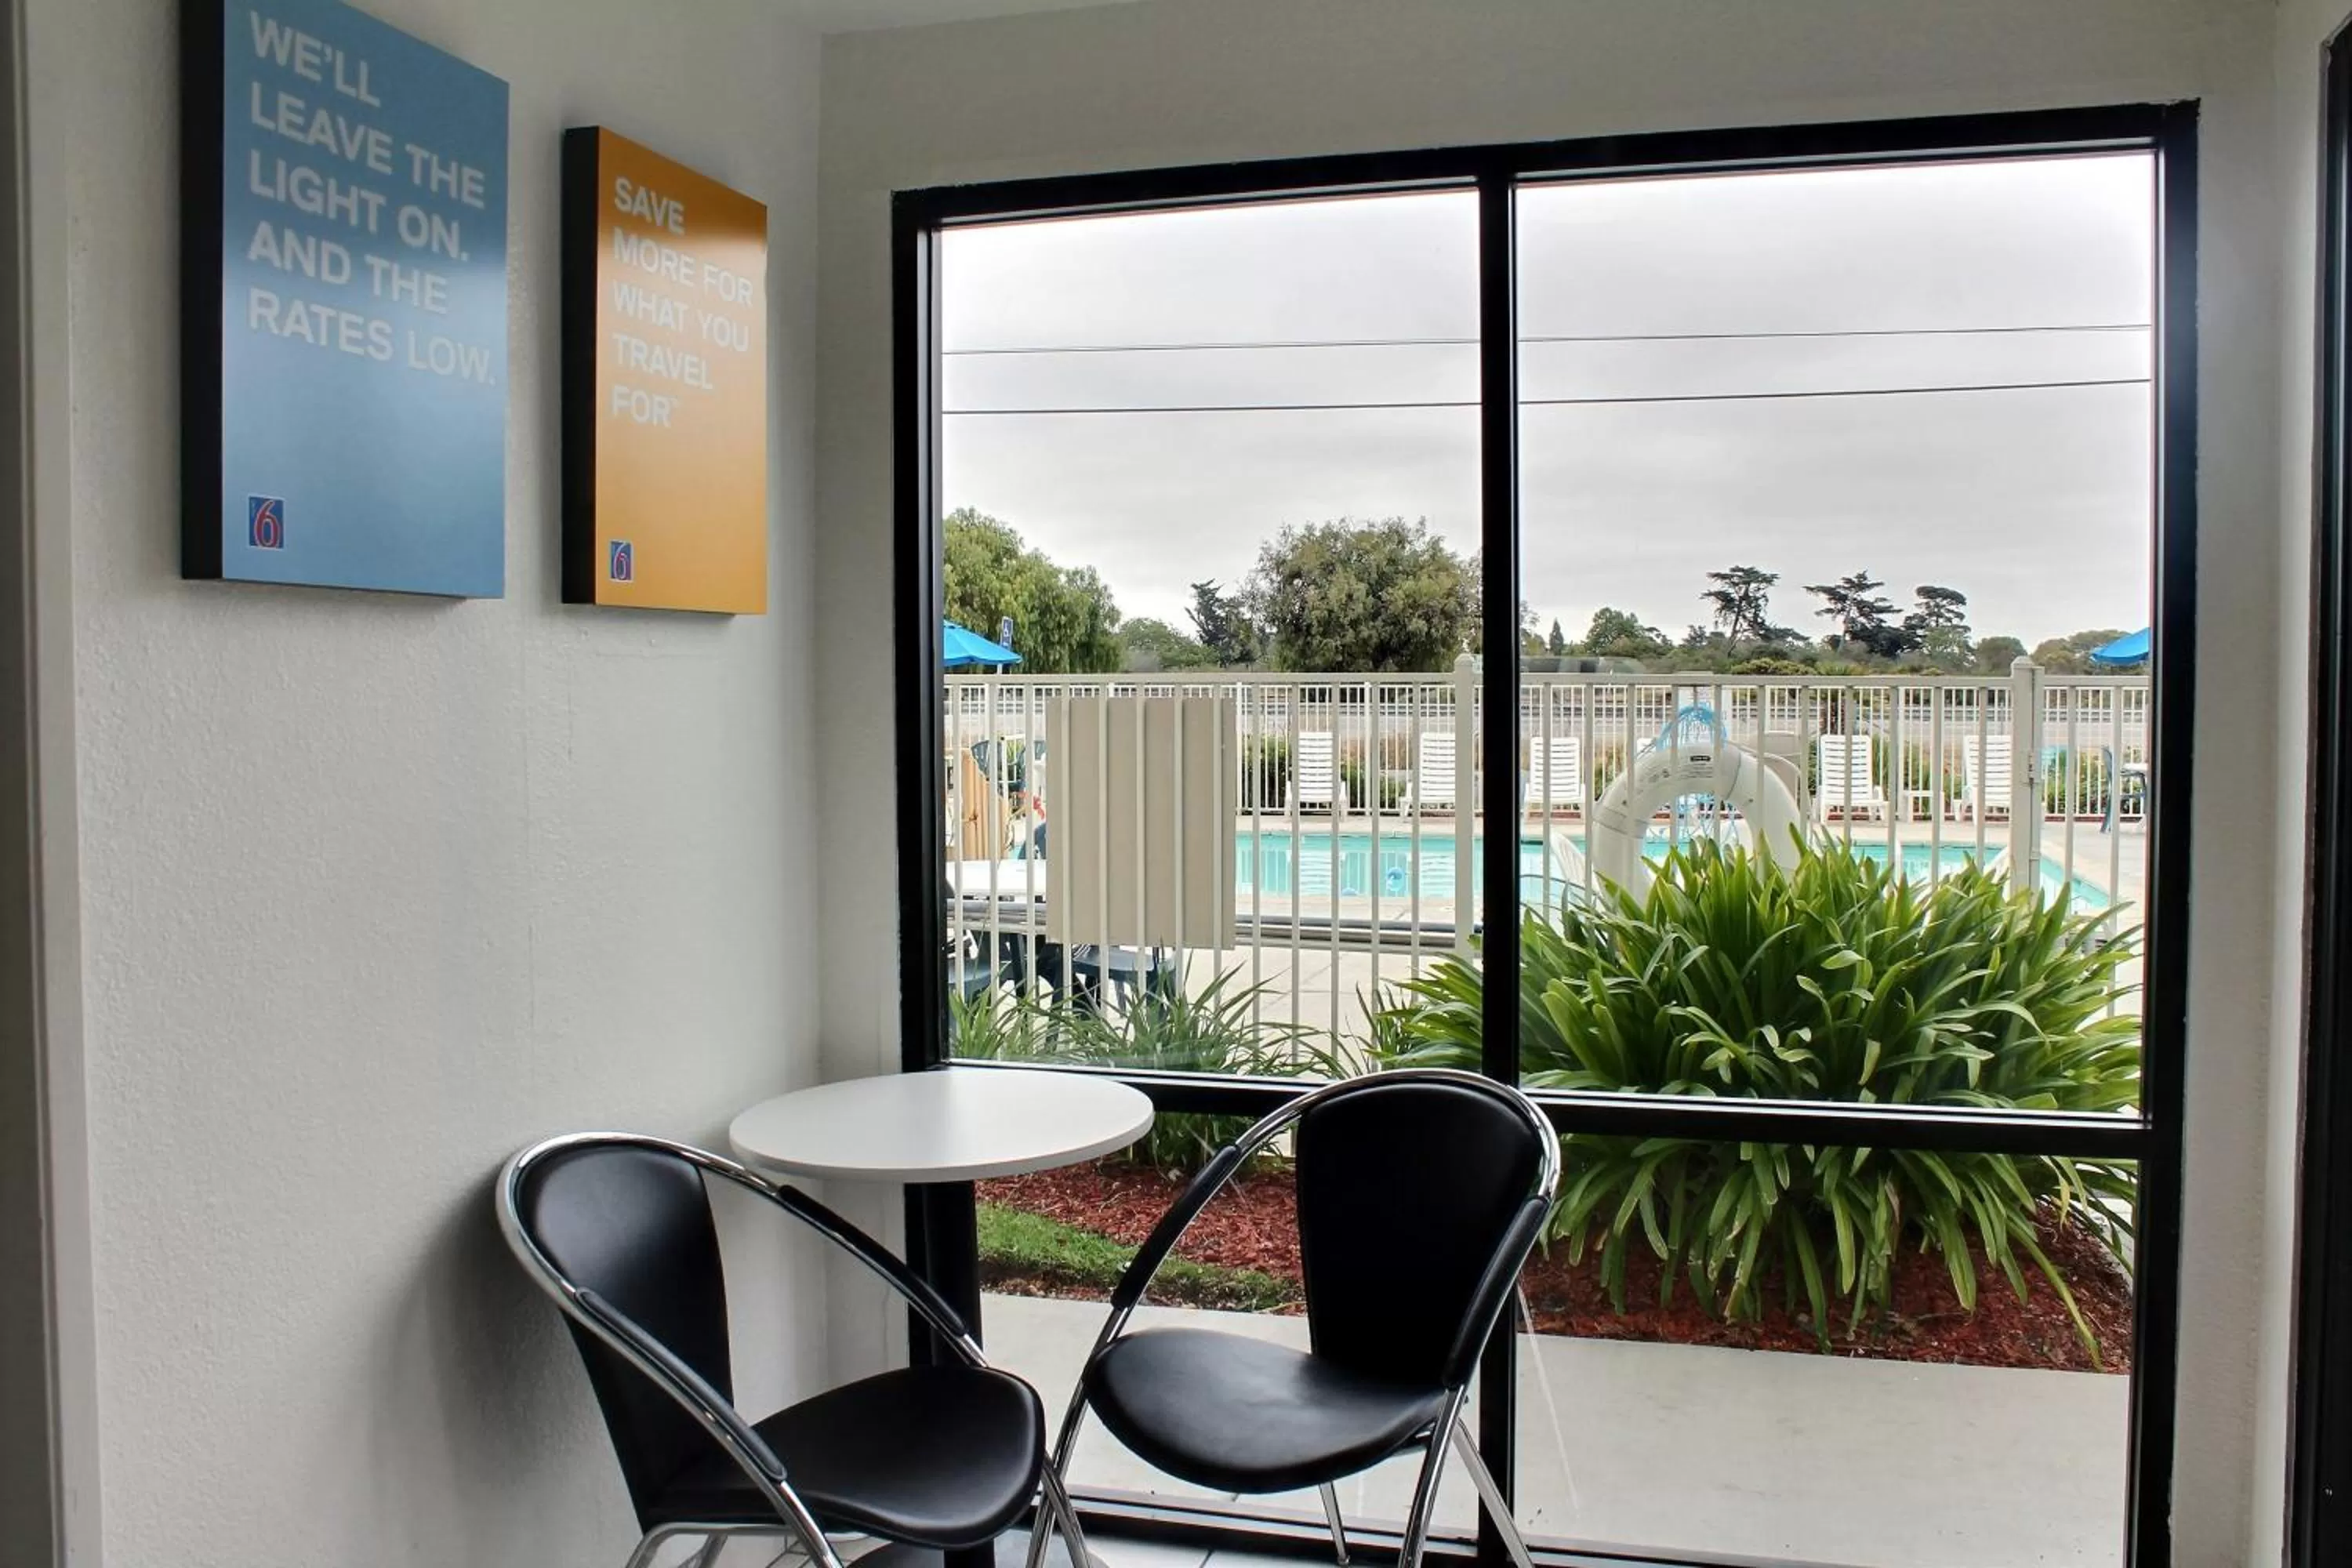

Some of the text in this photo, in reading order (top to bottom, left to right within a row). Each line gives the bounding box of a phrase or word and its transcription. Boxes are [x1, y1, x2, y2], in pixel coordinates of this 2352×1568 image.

[251, 11, 379, 106] WE'LL
[252, 82, 483, 208] LEAVE THE
[251, 151, 466, 260] LIGHT ON.
[615, 178, 684, 232] SAVE
[248, 221, 445, 314] AND THE
[615, 230, 752, 306] MORE FOR
[250, 289, 494, 384] RATES LOW.
[615, 284, 748, 350] WHAT YOU
[615, 336, 712, 389] TRAVEL
[254, 499, 280, 547] 6
[613, 543, 630, 580] 6
